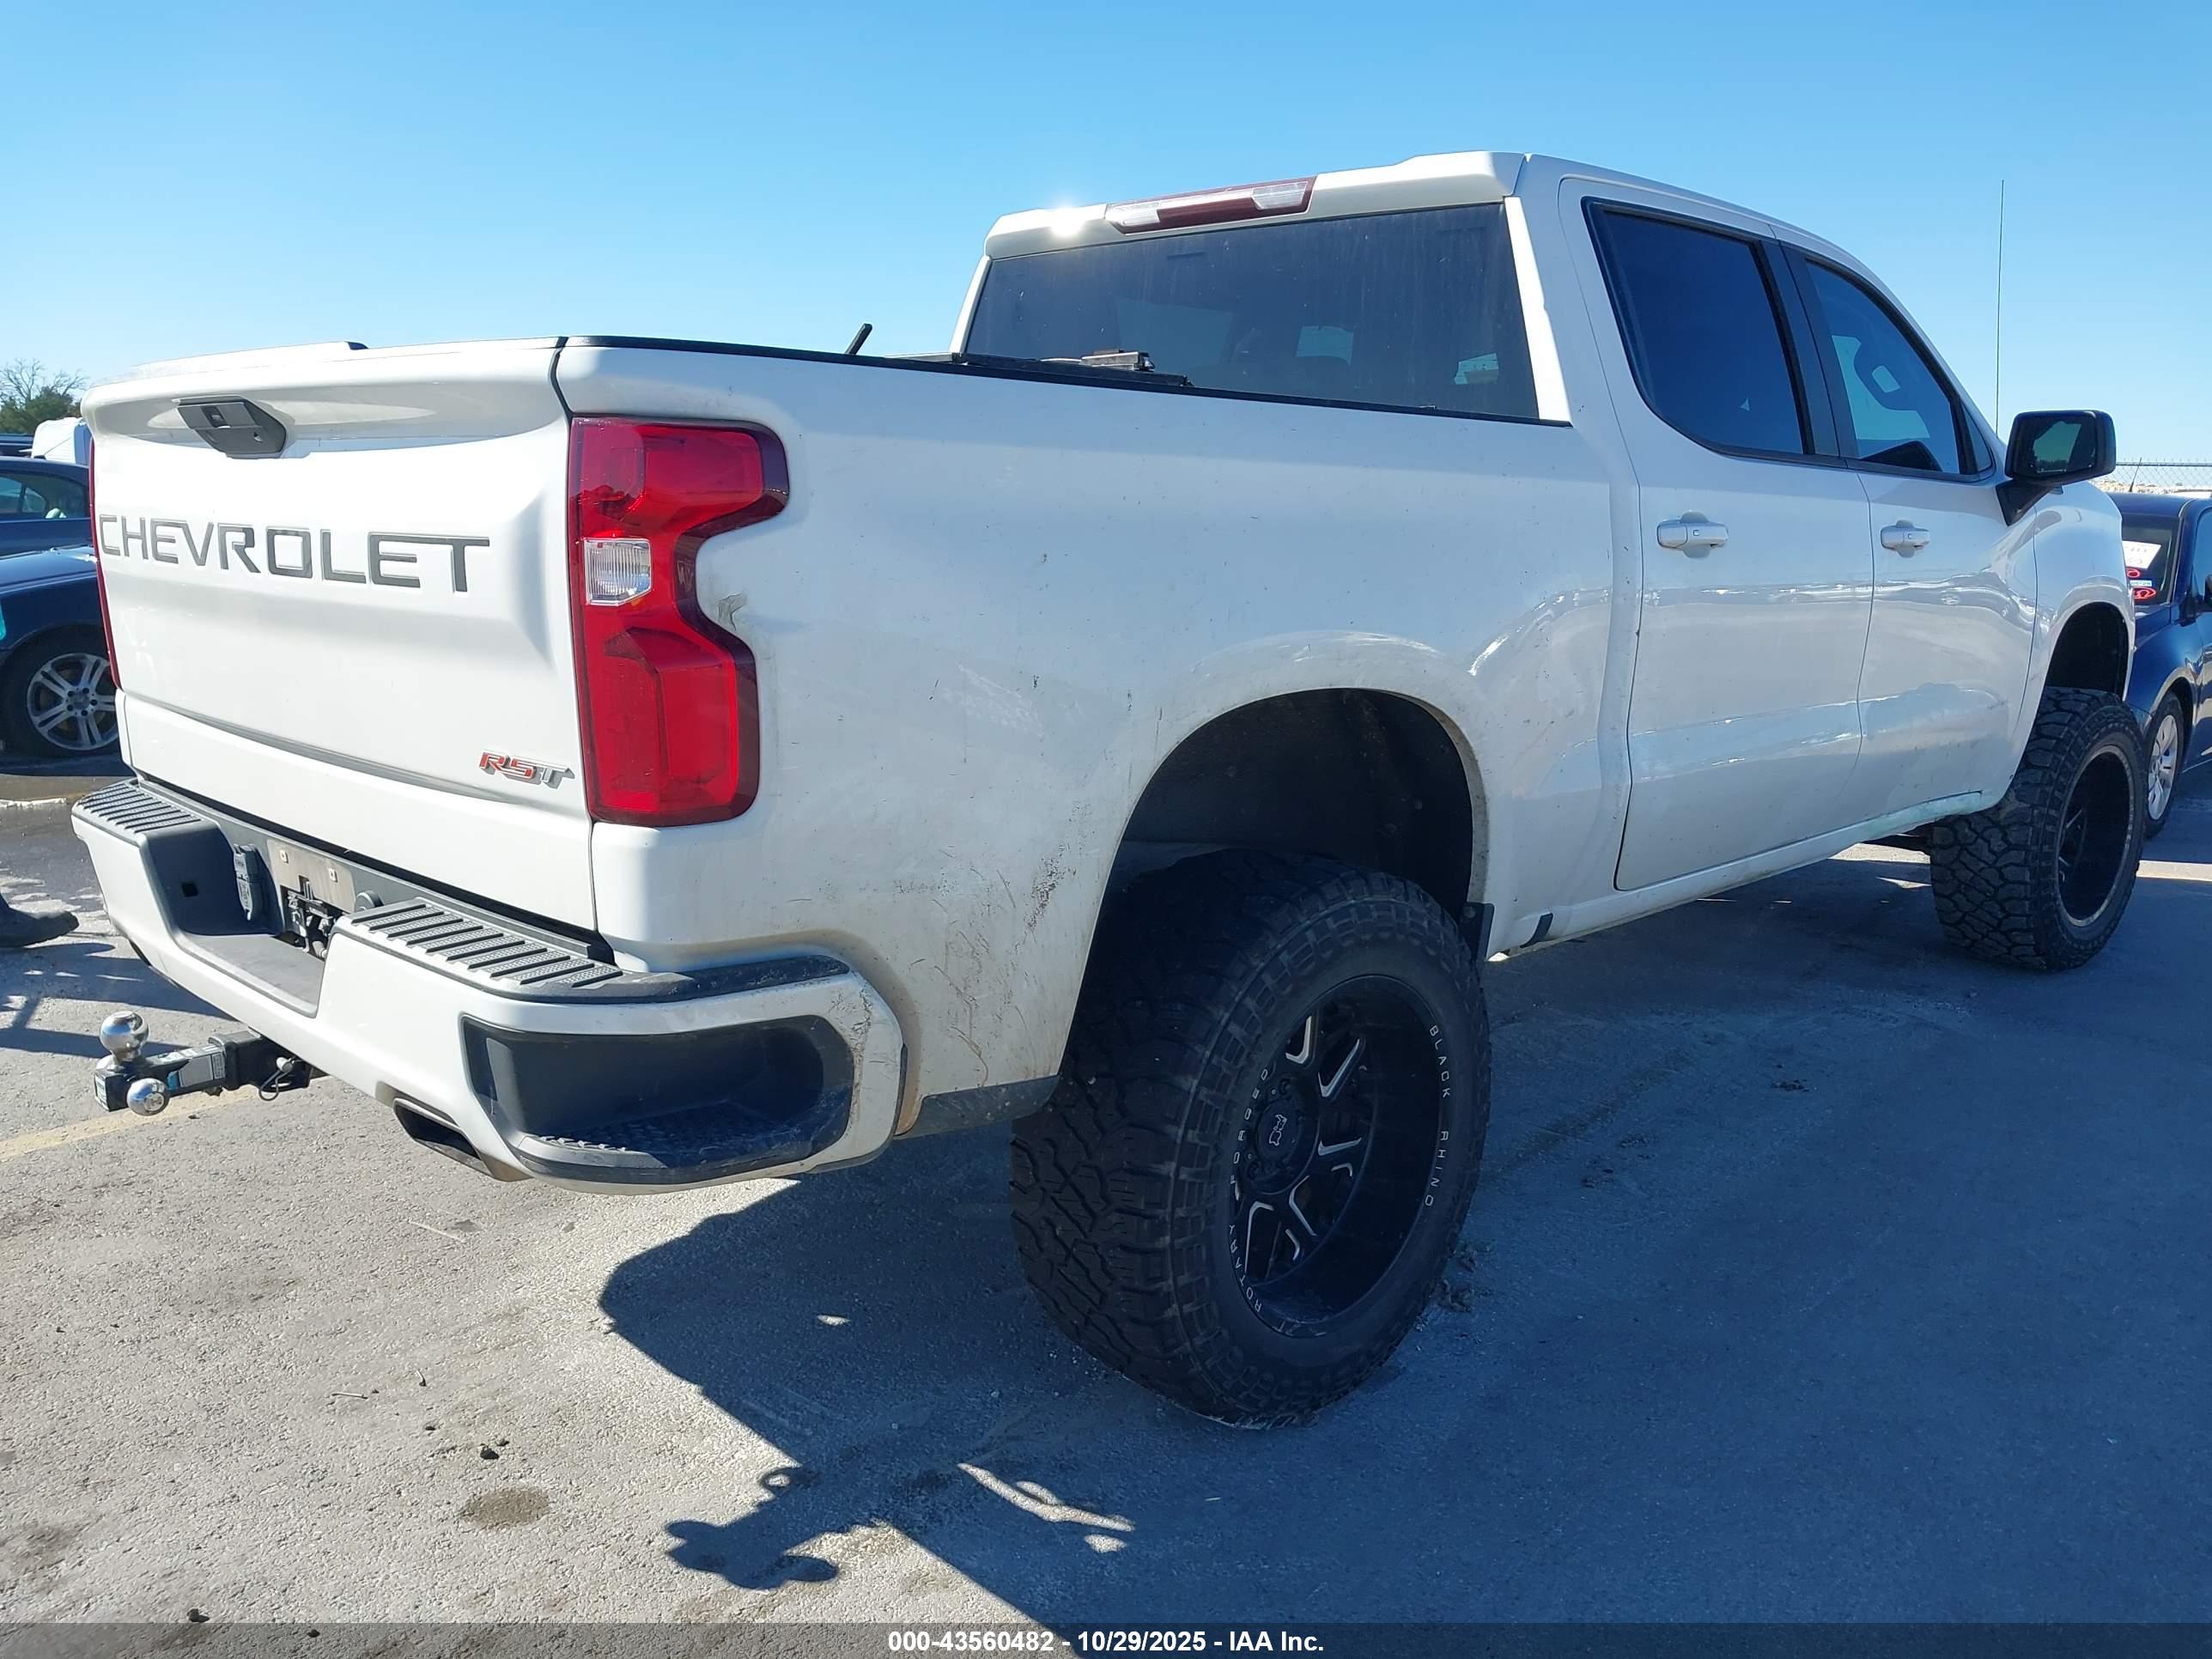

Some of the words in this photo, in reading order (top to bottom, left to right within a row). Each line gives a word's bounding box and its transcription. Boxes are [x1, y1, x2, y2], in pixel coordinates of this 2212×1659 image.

[99, 514, 491, 592] CHEVROLET
[477, 750, 575, 789] RST
[1428, 1024, 1451, 1099] BLACK
[1424, 1129, 1450, 1207] RHINO
